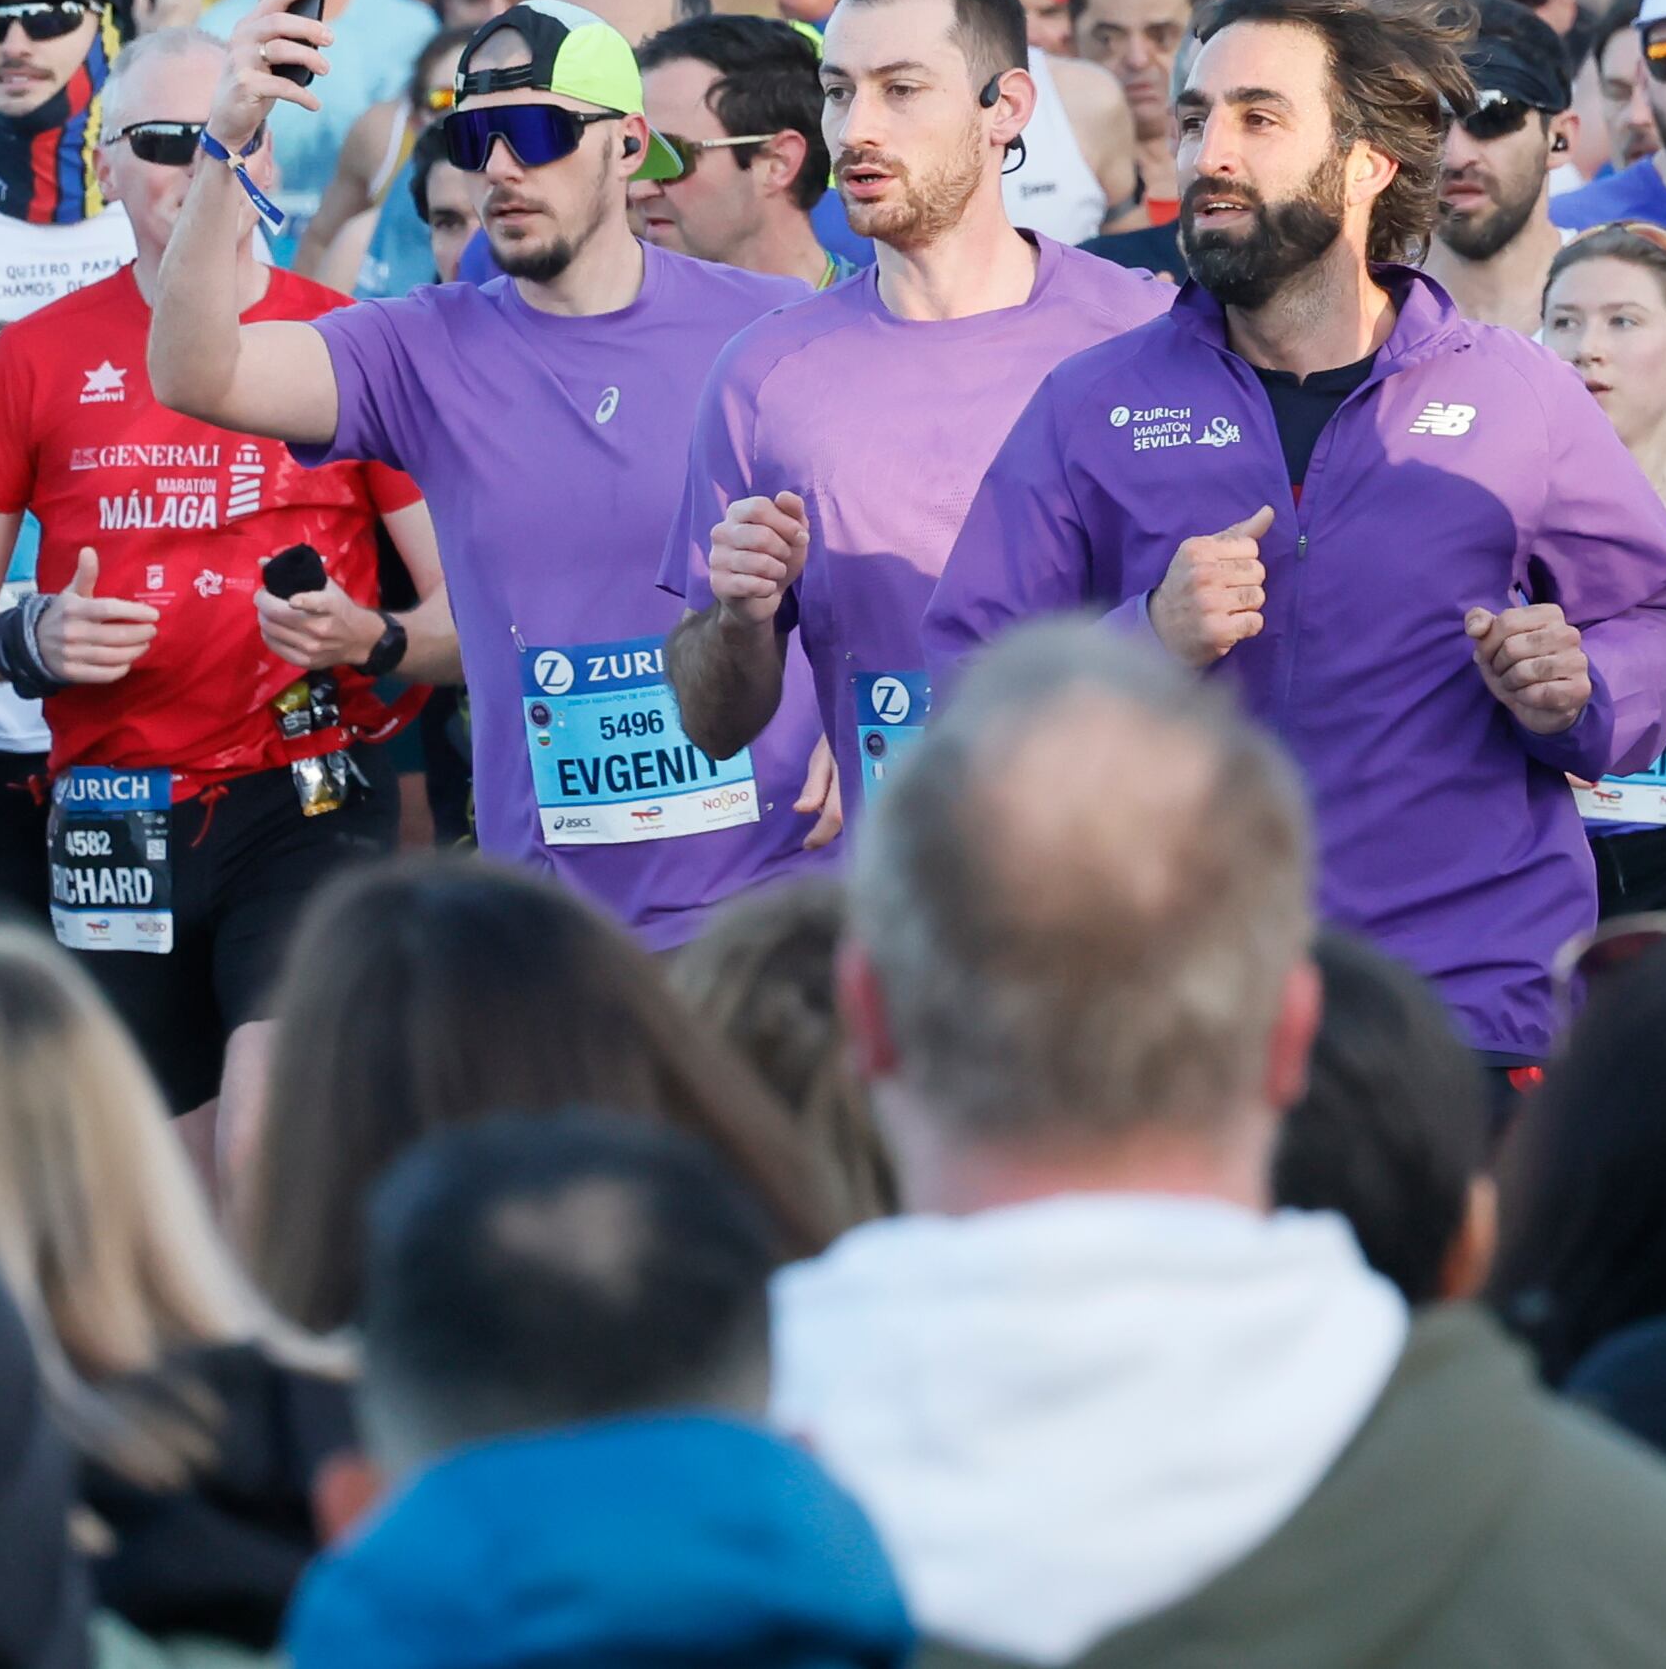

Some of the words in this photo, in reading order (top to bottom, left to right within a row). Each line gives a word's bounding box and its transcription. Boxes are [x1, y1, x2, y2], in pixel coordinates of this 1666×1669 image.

[6, 262, 71, 278] QUIERO
[1132, 407, 1191, 422] ZURICH
[1133, 421, 1191, 438] MARATÓN
[1133, 432, 1192, 451] SEVILLA
[99, 443, 221, 467] GENERALI
[155, 476, 217, 494] MARATÓN
[98, 488, 218, 530] MÁLAGA
[586, 648, 665, 682] ZURI
[599, 709, 665, 741] 5496
[556, 743, 718, 797] EVGENIY
[64, 830, 113, 857] 4582
